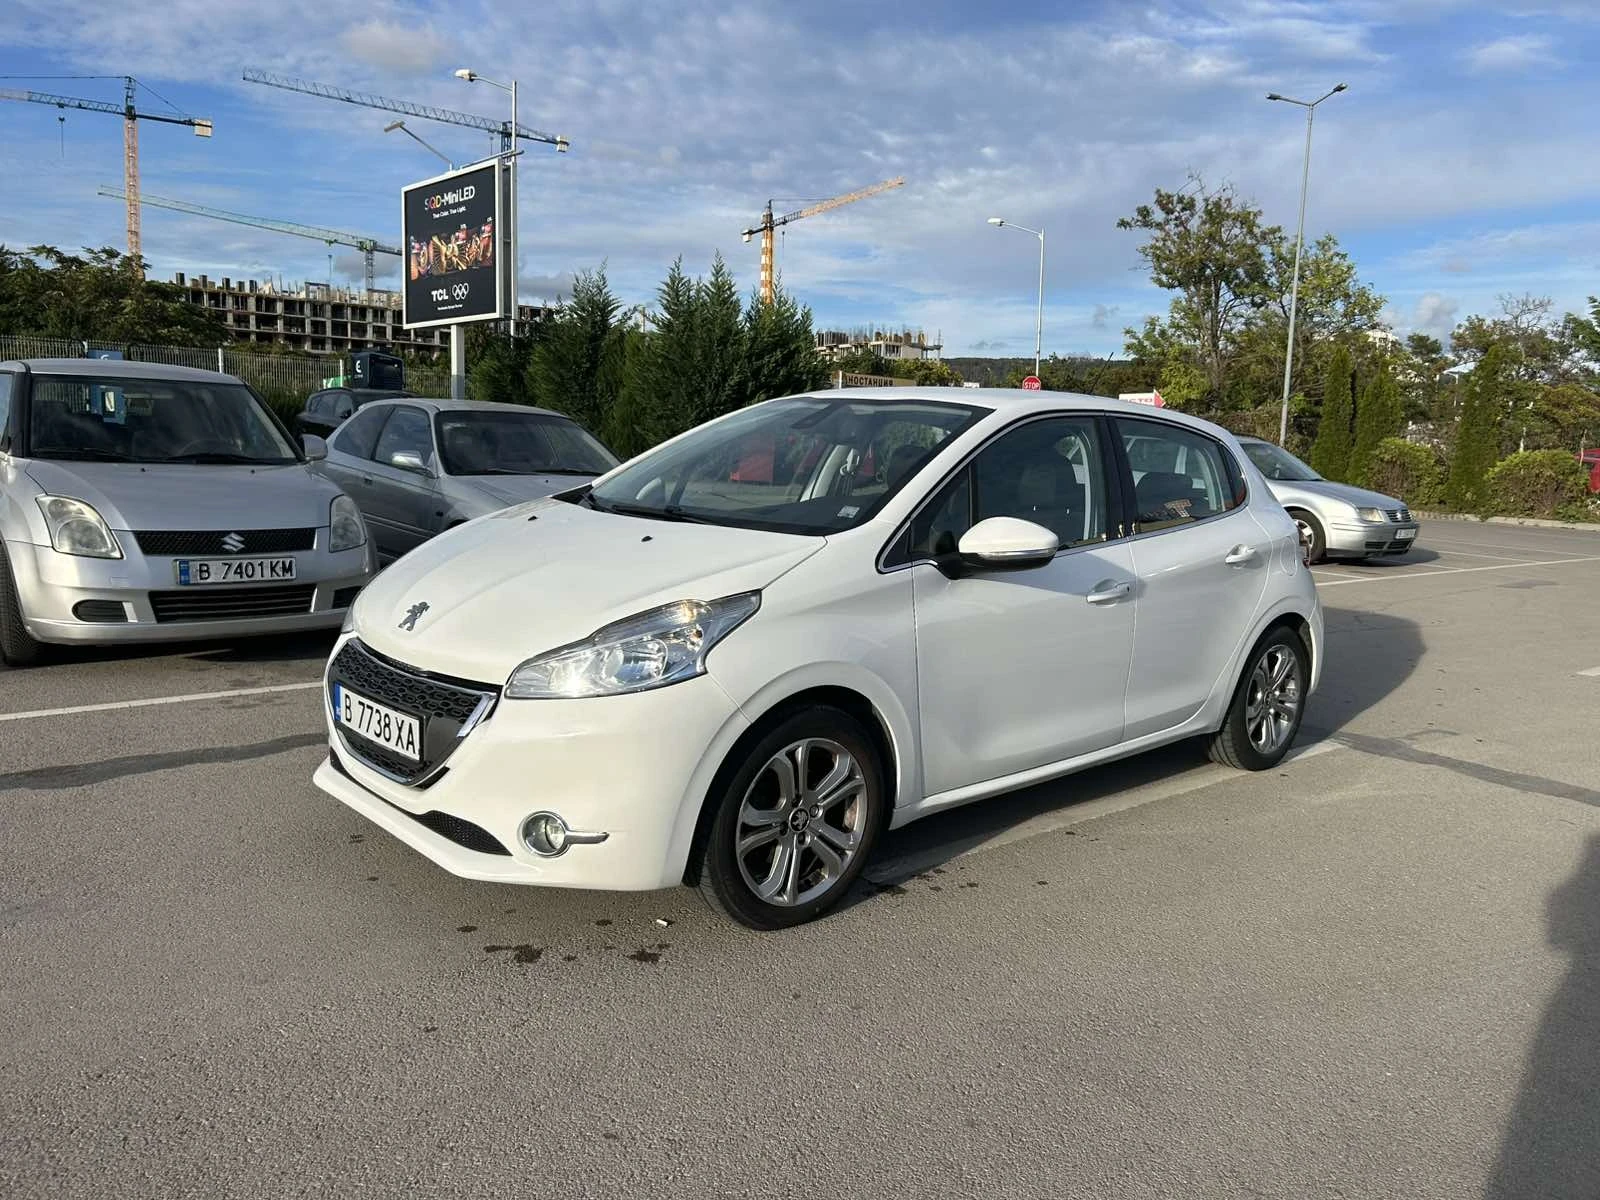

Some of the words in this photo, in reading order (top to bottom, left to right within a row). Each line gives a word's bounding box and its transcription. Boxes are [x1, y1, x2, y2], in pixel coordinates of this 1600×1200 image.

[431, 288, 449, 302] TCL
[1024, 381, 1040, 389] STOP
[199, 563, 210, 580] B
[345, 693, 352, 723] B
